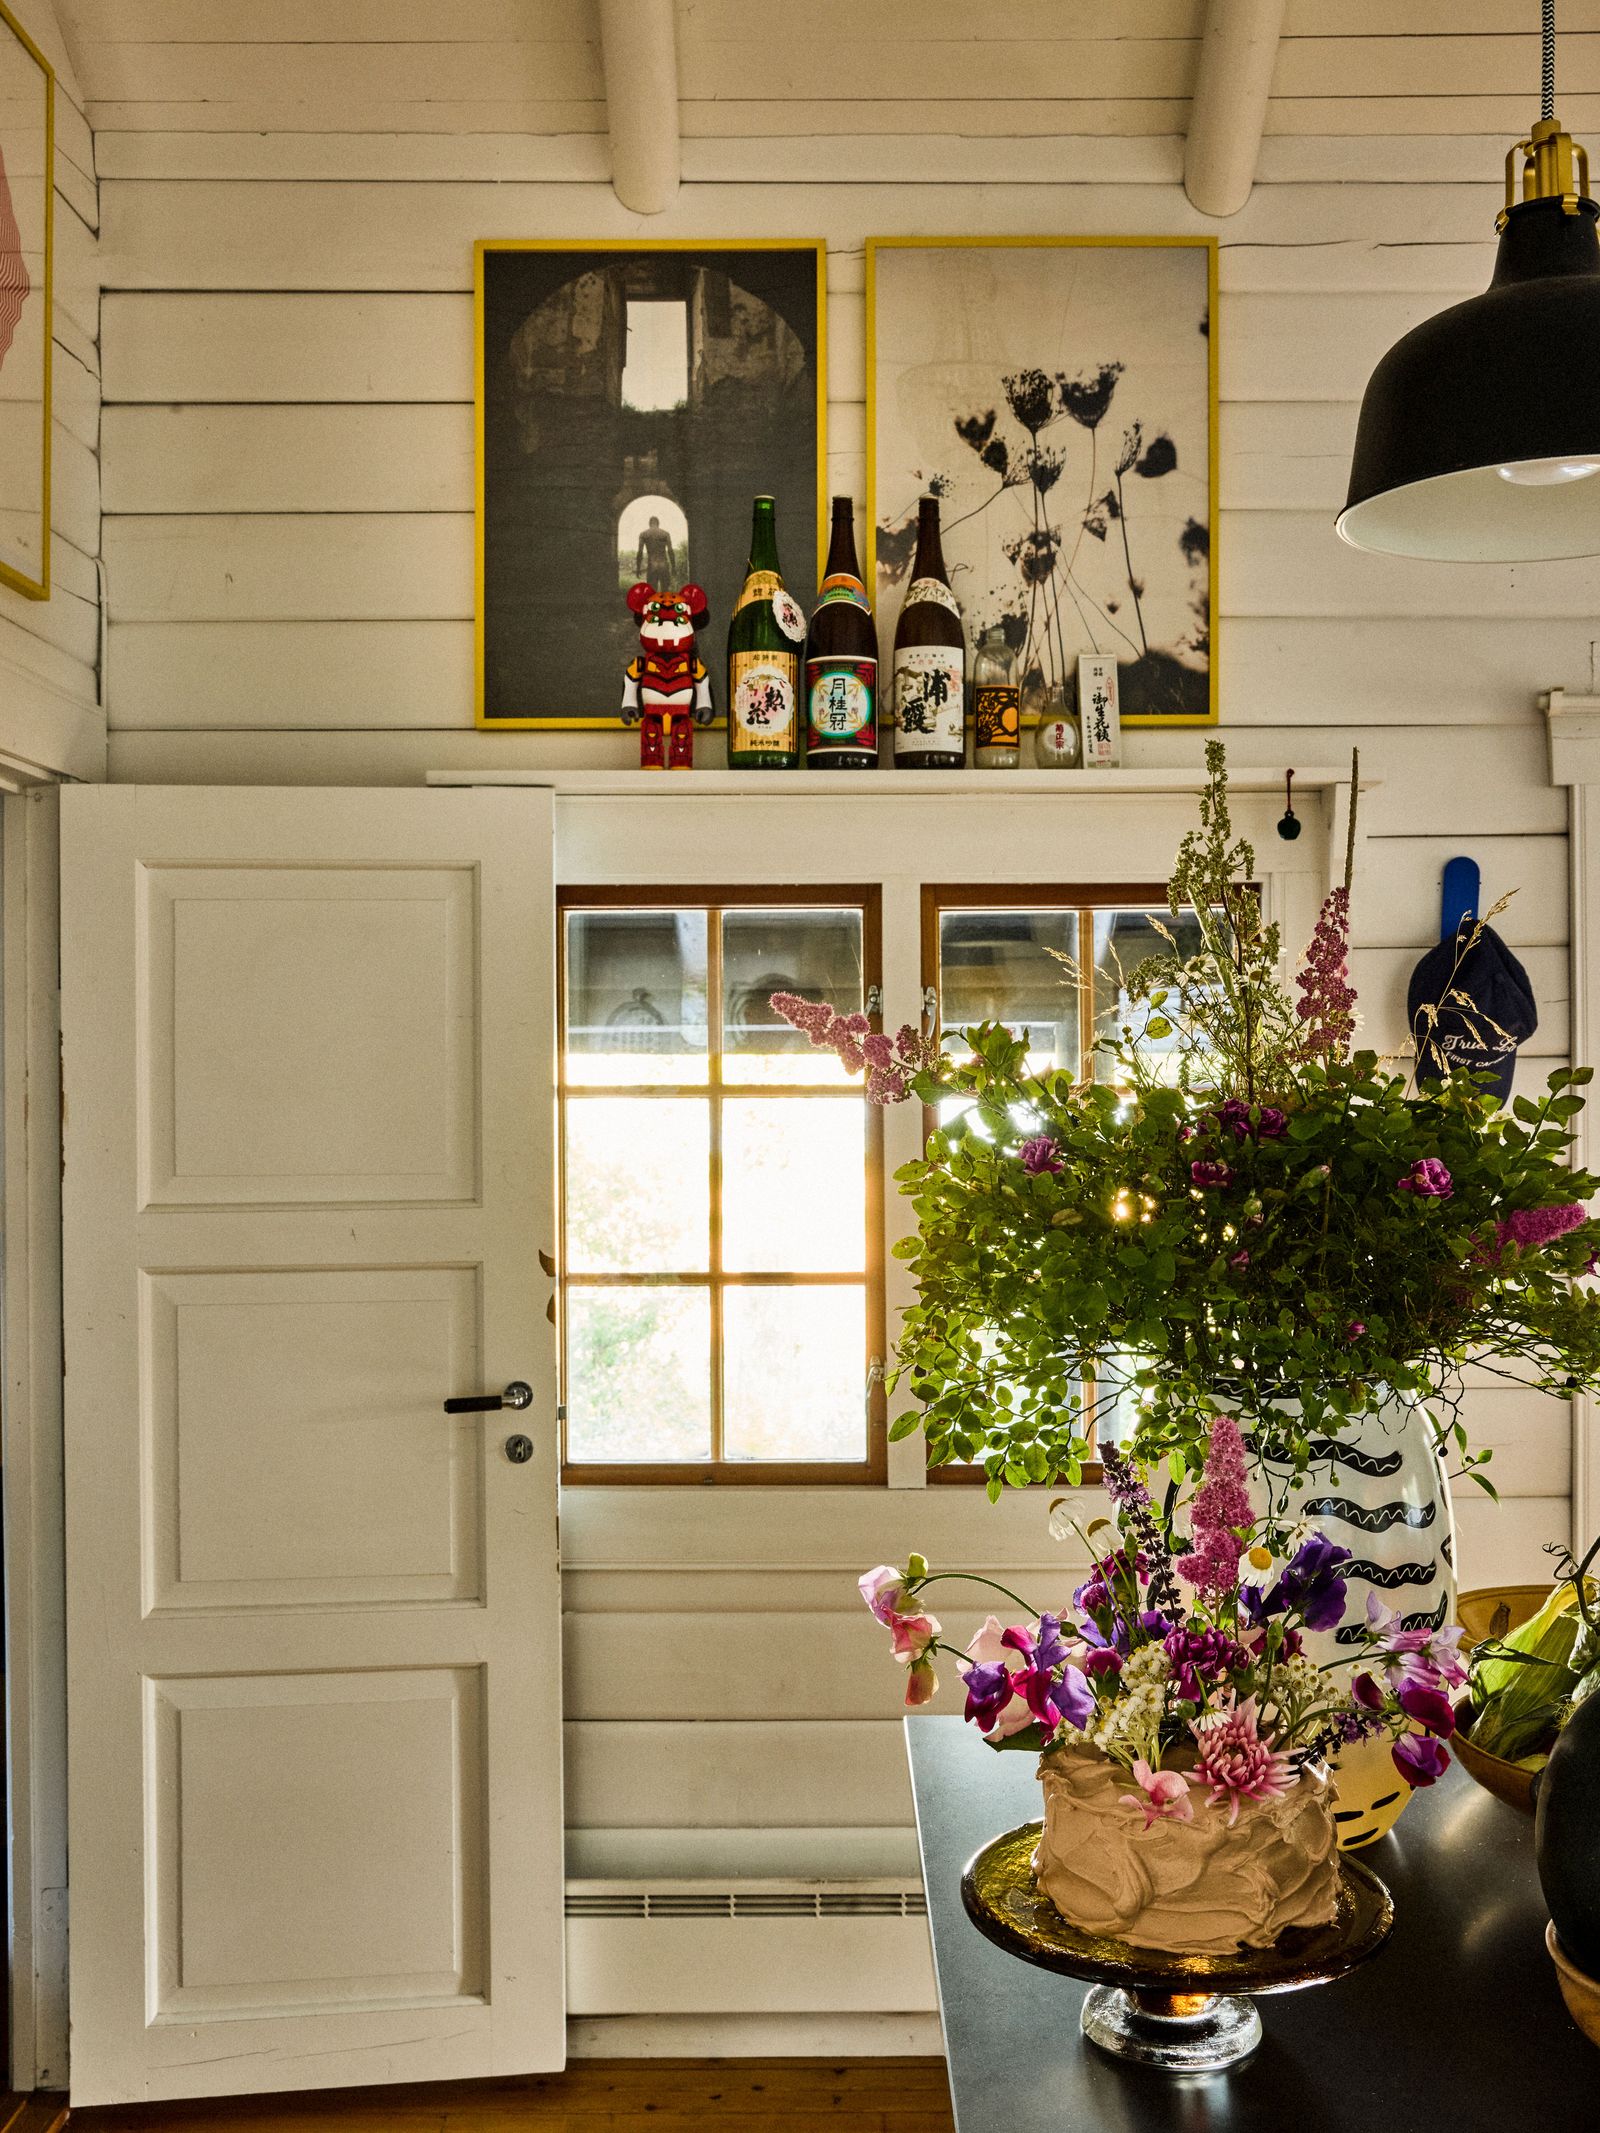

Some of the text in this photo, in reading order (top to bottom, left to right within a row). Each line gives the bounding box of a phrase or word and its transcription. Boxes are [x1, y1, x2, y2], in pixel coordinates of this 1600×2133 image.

[829, 678, 848, 731] 月桂冠
[1055, 723, 1065, 750] 菊正宗
[1441, 1034, 1487, 1050] True
[1445, 1051, 1472, 1066] FIRST
